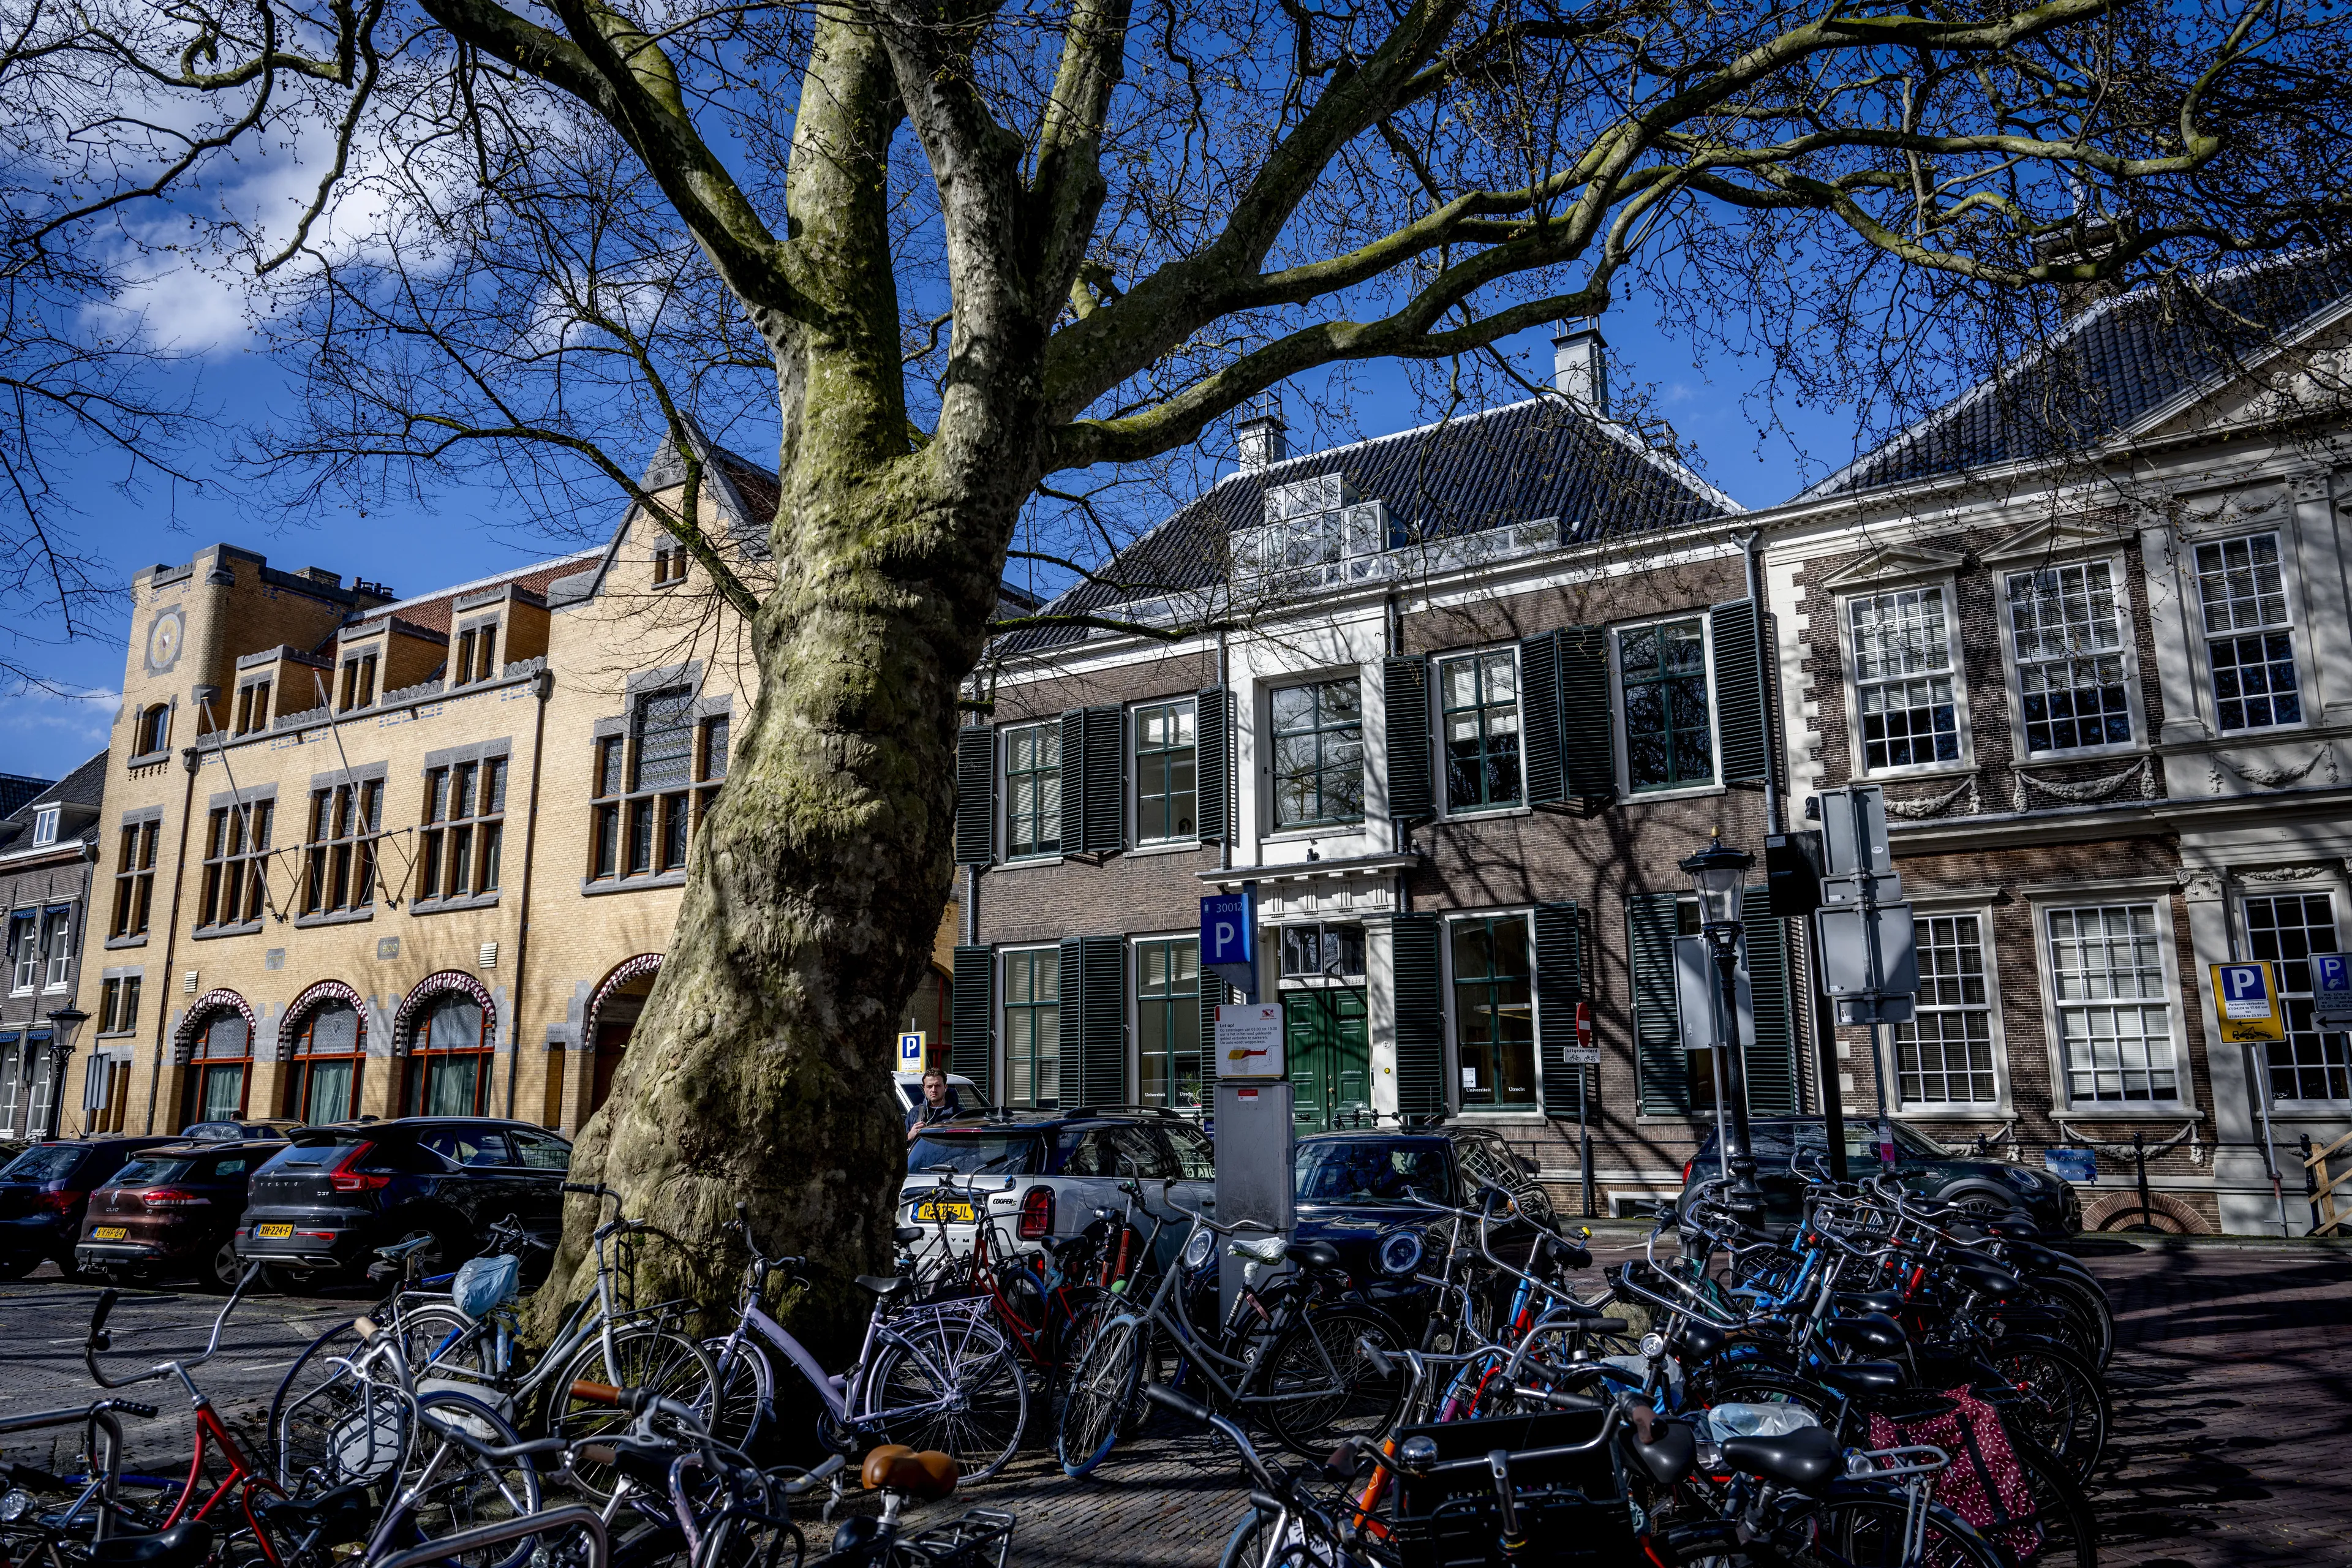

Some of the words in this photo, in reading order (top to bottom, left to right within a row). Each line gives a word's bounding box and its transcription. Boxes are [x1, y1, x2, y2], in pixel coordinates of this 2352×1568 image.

[1216, 902, 1243, 913] 30012
[1216, 922, 1235, 958] P
[2324, 959, 2341, 977] P
[2231, 968, 2255, 998] P
[907, 1037, 917, 1057] P
[96, 1227, 124, 1237] 6-KHF-84
[260, 1226, 290, 1235] XH-224-F
